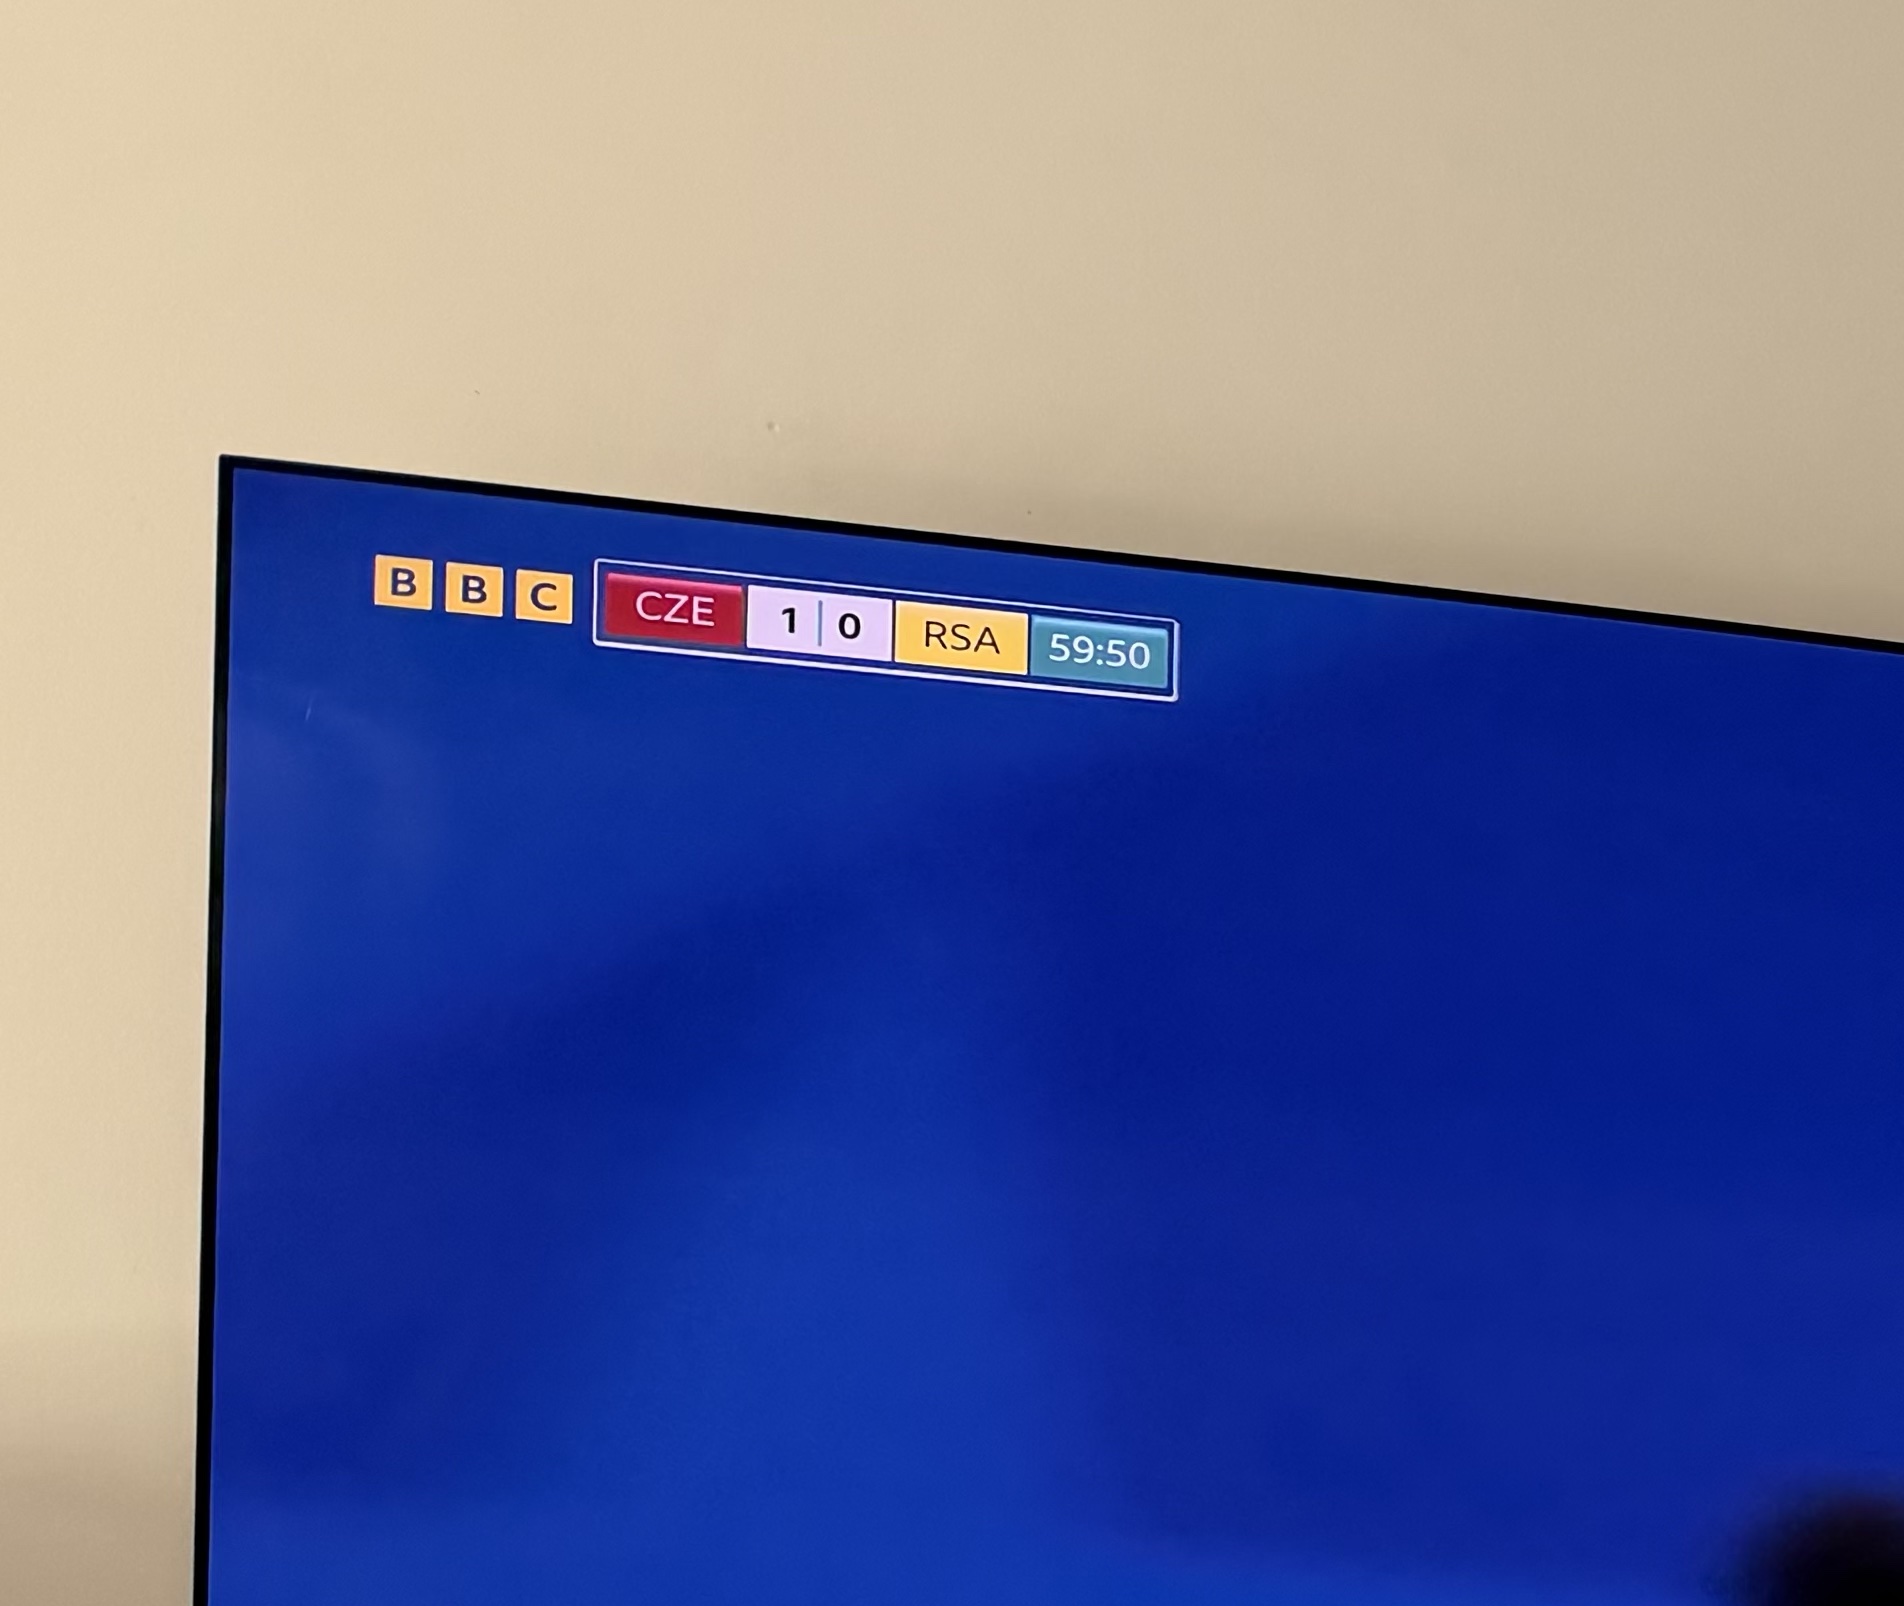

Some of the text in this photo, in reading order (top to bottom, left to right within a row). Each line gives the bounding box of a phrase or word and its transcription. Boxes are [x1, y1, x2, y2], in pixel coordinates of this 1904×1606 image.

[636, 591, 1151, 669] CZE 1 0 RSA 59:50
